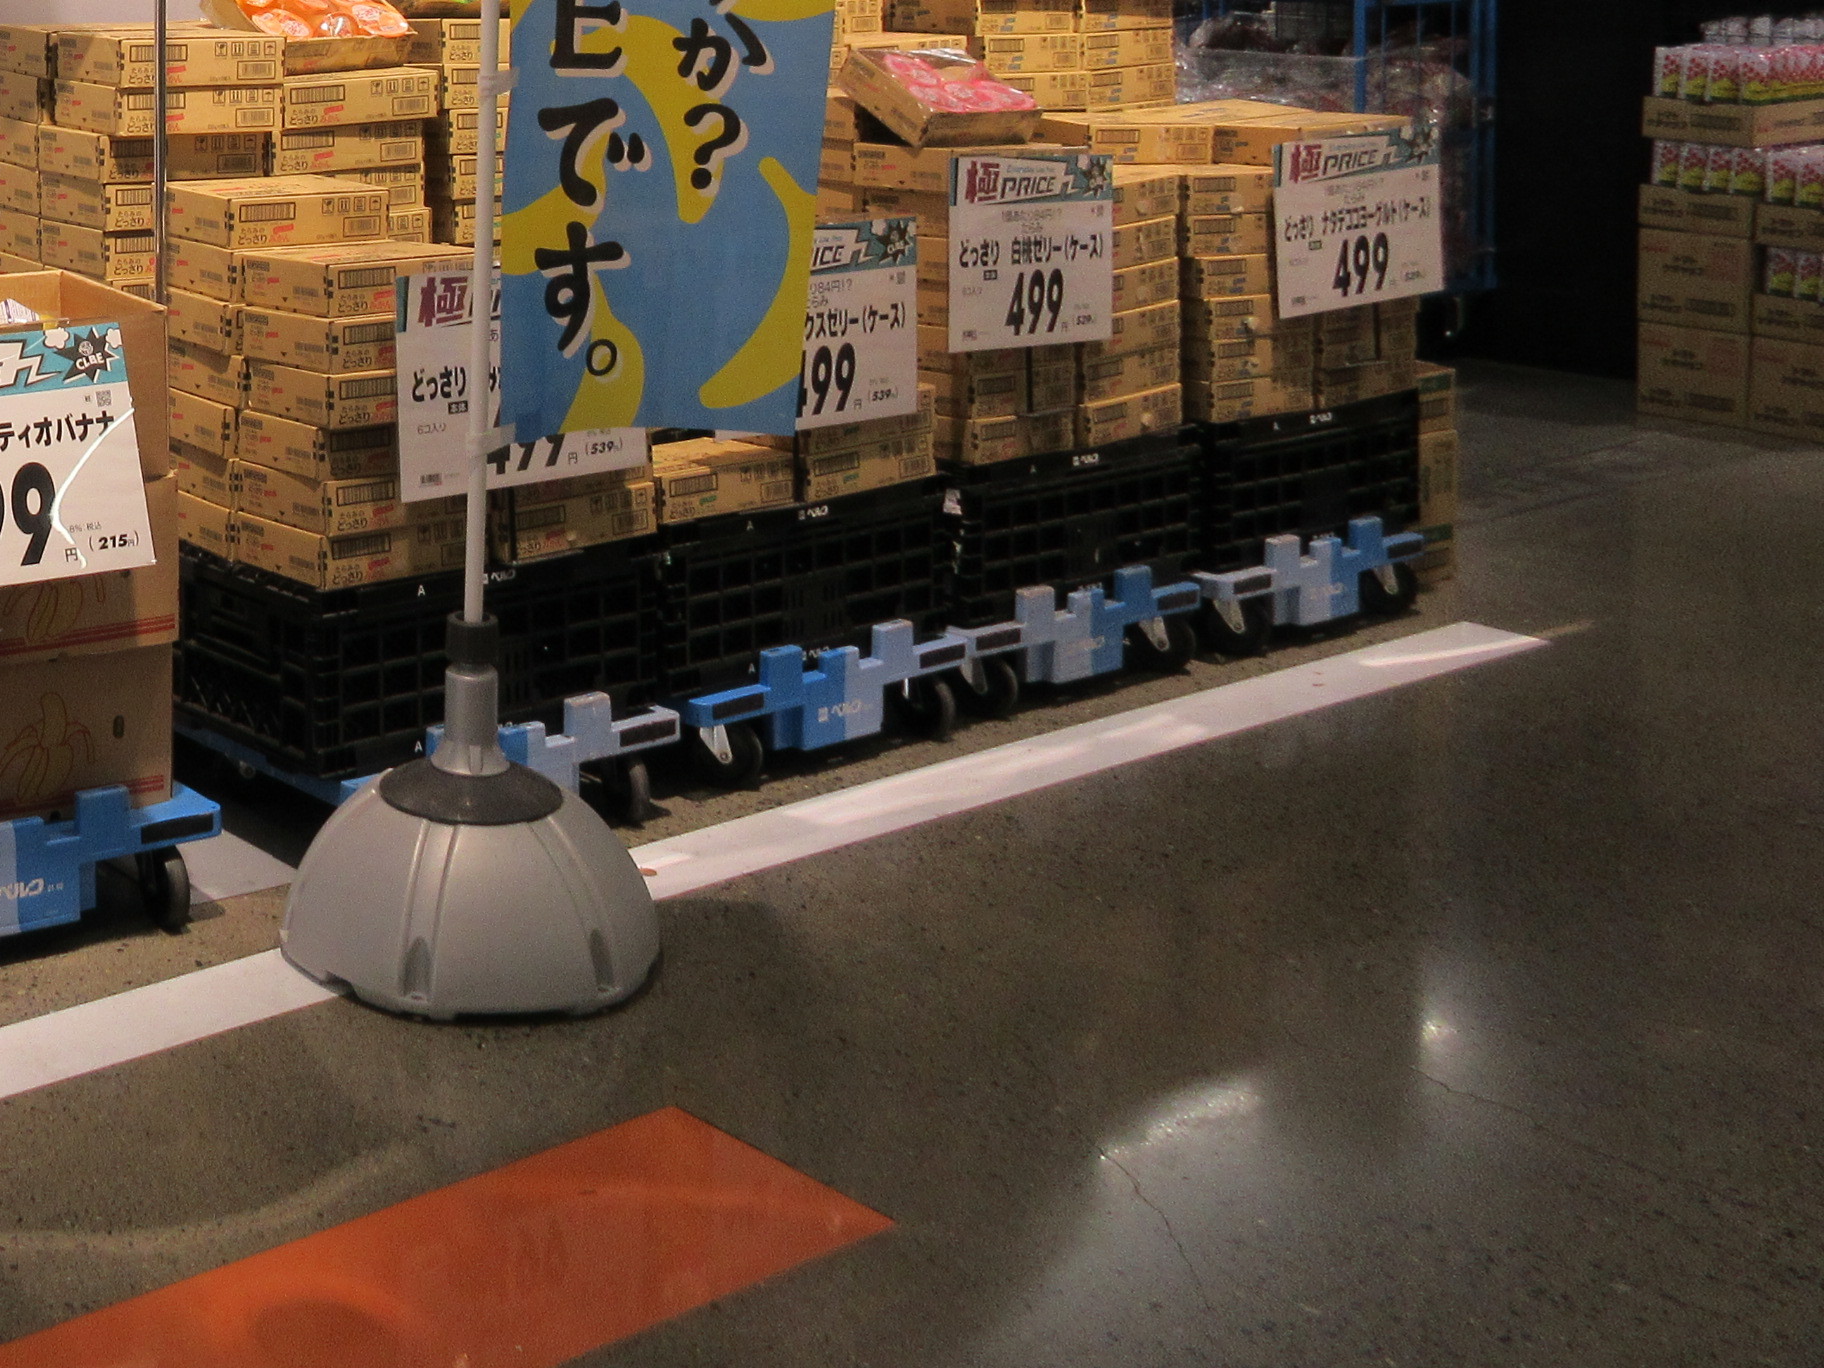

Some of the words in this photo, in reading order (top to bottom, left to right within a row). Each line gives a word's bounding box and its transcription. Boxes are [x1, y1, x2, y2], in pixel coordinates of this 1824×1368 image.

[455, 139, 478, 151] どっさ
[1322, 148, 1379, 177] PRICE
[964, 160, 1001, 204] 極
[1000, 175, 1057, 200] PRICE
[812, 245, 845, 267] ICE
[959, 238, 1000, 269] どっさり
[1332, 232, 1389, 298] 499
[418, 277, 469, 327] 極
[810, 278, 853, 296] り84円!?
[1004, 268, 1064, 336] 499
[805, 301, 906, 341] クスゼリー(ケース)
[76, 352, 105, 371] CLBE
[412, 365, 467, 403] どっさり
[800, 342, 856, 419] 99
